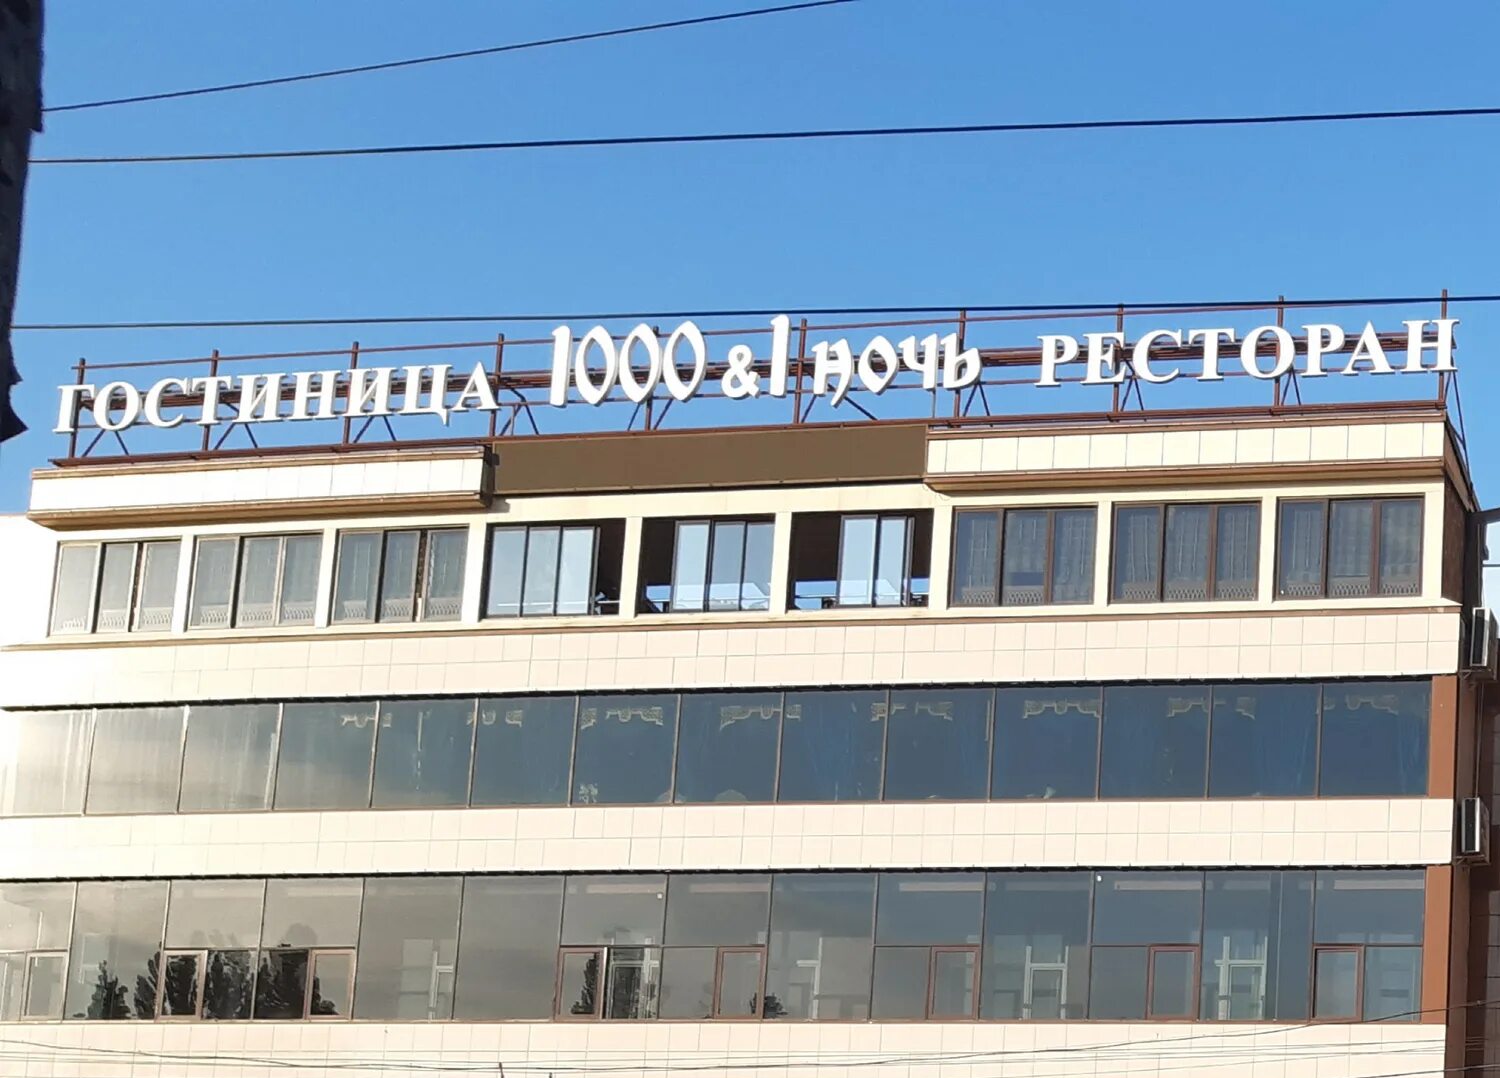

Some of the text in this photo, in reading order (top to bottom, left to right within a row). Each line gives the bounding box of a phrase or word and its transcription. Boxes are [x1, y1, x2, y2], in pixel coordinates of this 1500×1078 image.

[52, 361, 499, 433] ГОСТИНИЦА
[550, 321, 707, 406] 1000
[1034, 318, 1460, 387] РЕСТОРАН
